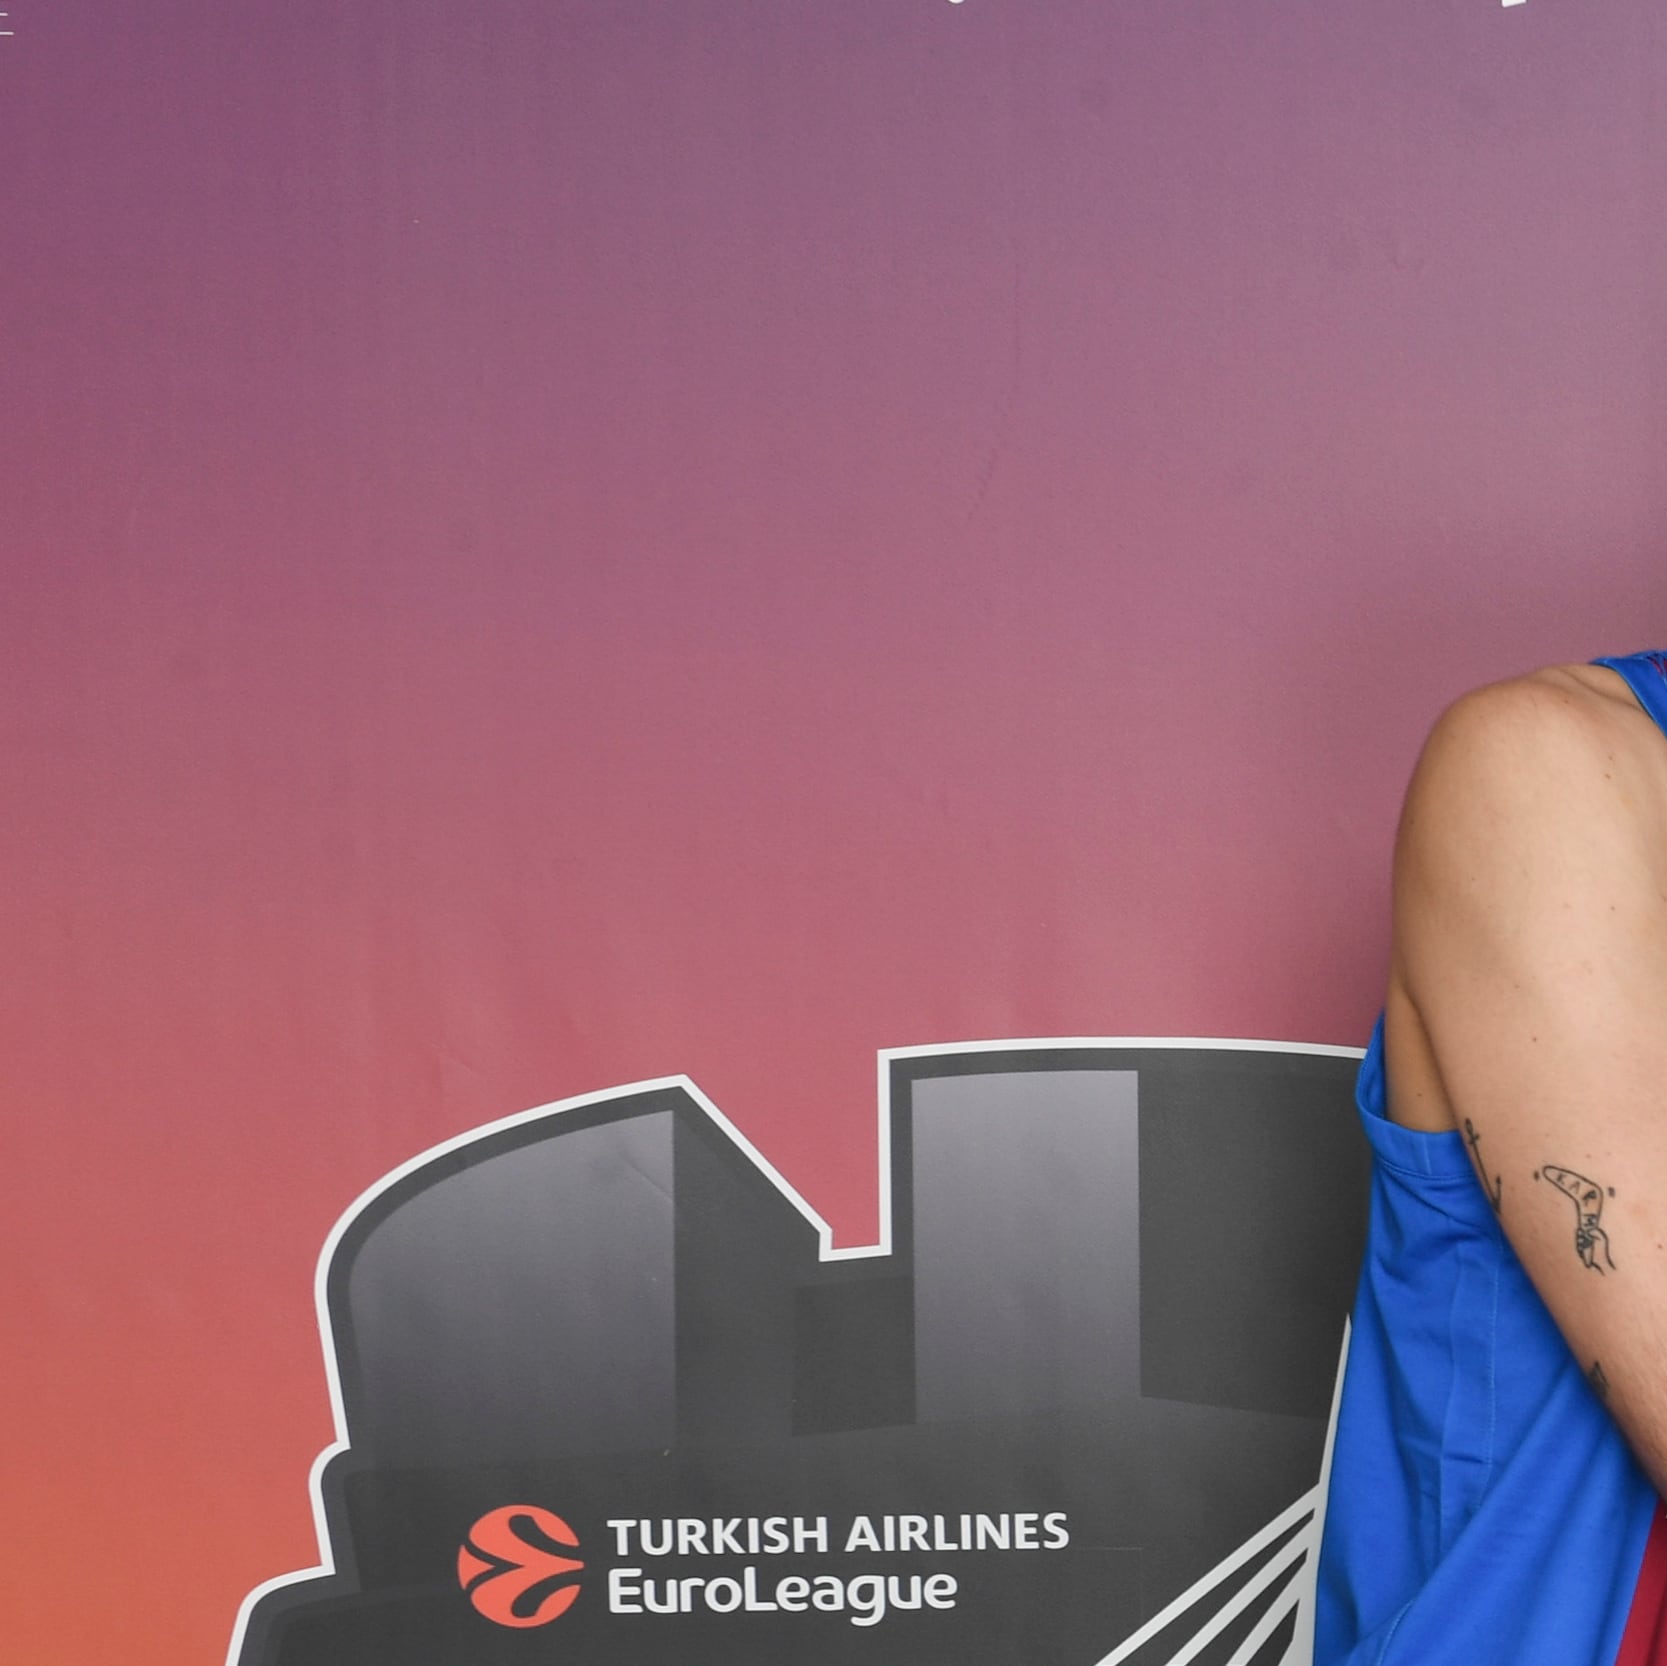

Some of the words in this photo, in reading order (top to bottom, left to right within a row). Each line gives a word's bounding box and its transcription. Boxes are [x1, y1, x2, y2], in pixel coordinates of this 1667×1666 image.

[606, 1516, 829, 1556] TURKISH
[844, 1512, 1071, 1552] AIRLINES
[607, 1566, 958, 1627] EuroLeague
